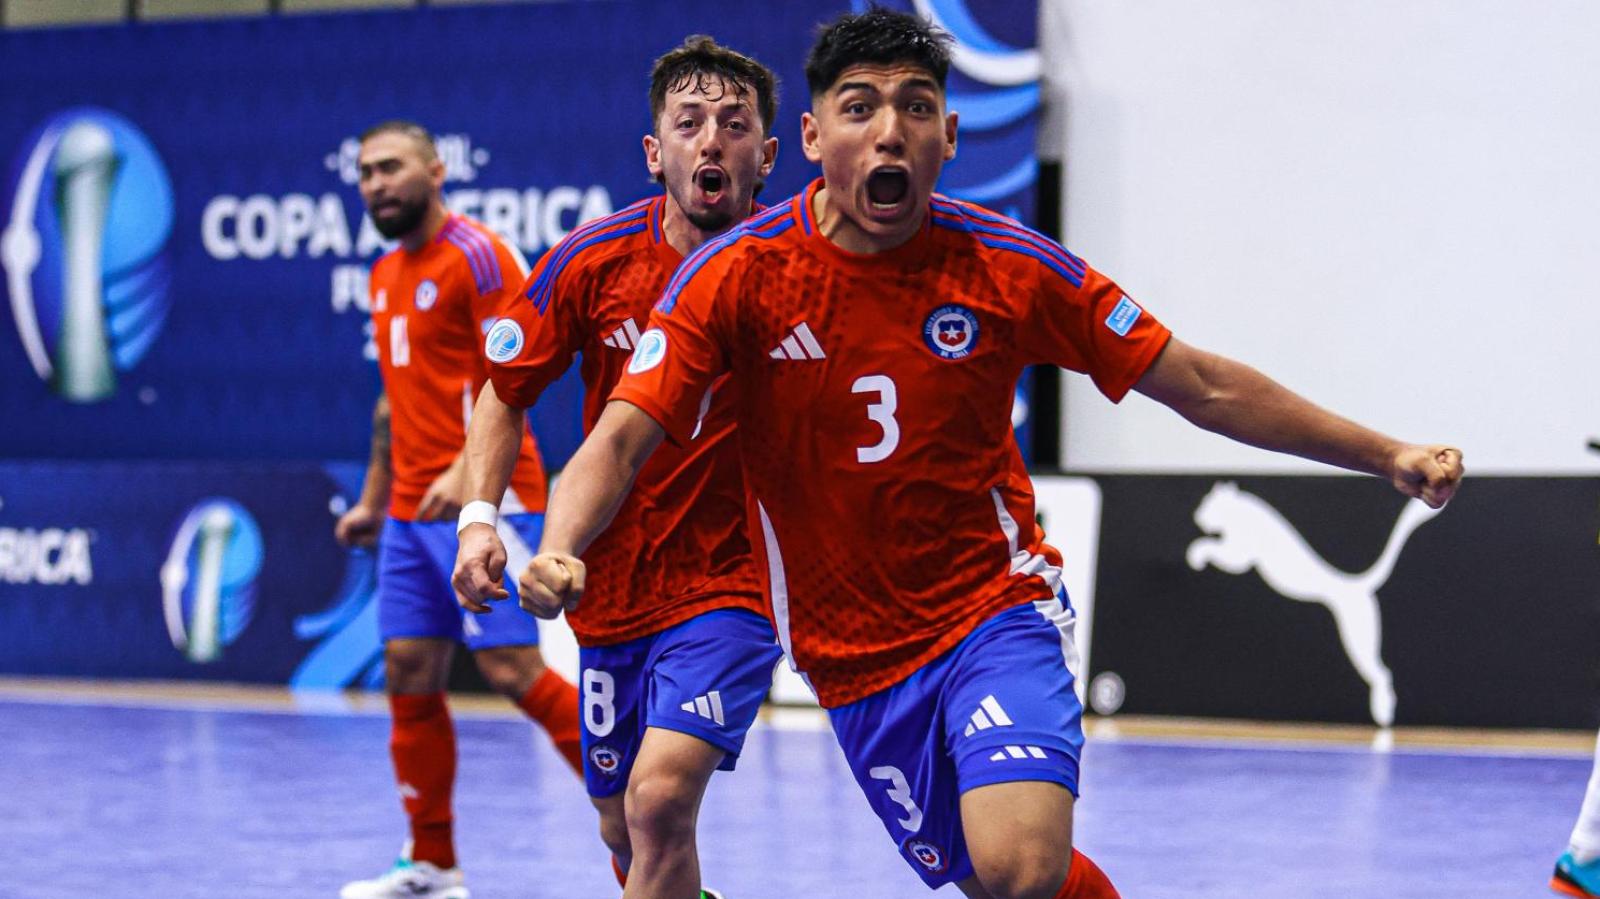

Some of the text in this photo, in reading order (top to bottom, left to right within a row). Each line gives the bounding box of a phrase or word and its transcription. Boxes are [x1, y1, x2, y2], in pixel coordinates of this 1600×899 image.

[201, 193, 352, 259] COPA
[851, 374, 900, 463] 3
[583, 667, 616, 738] 8
[869, 765, 923, 833] 3
